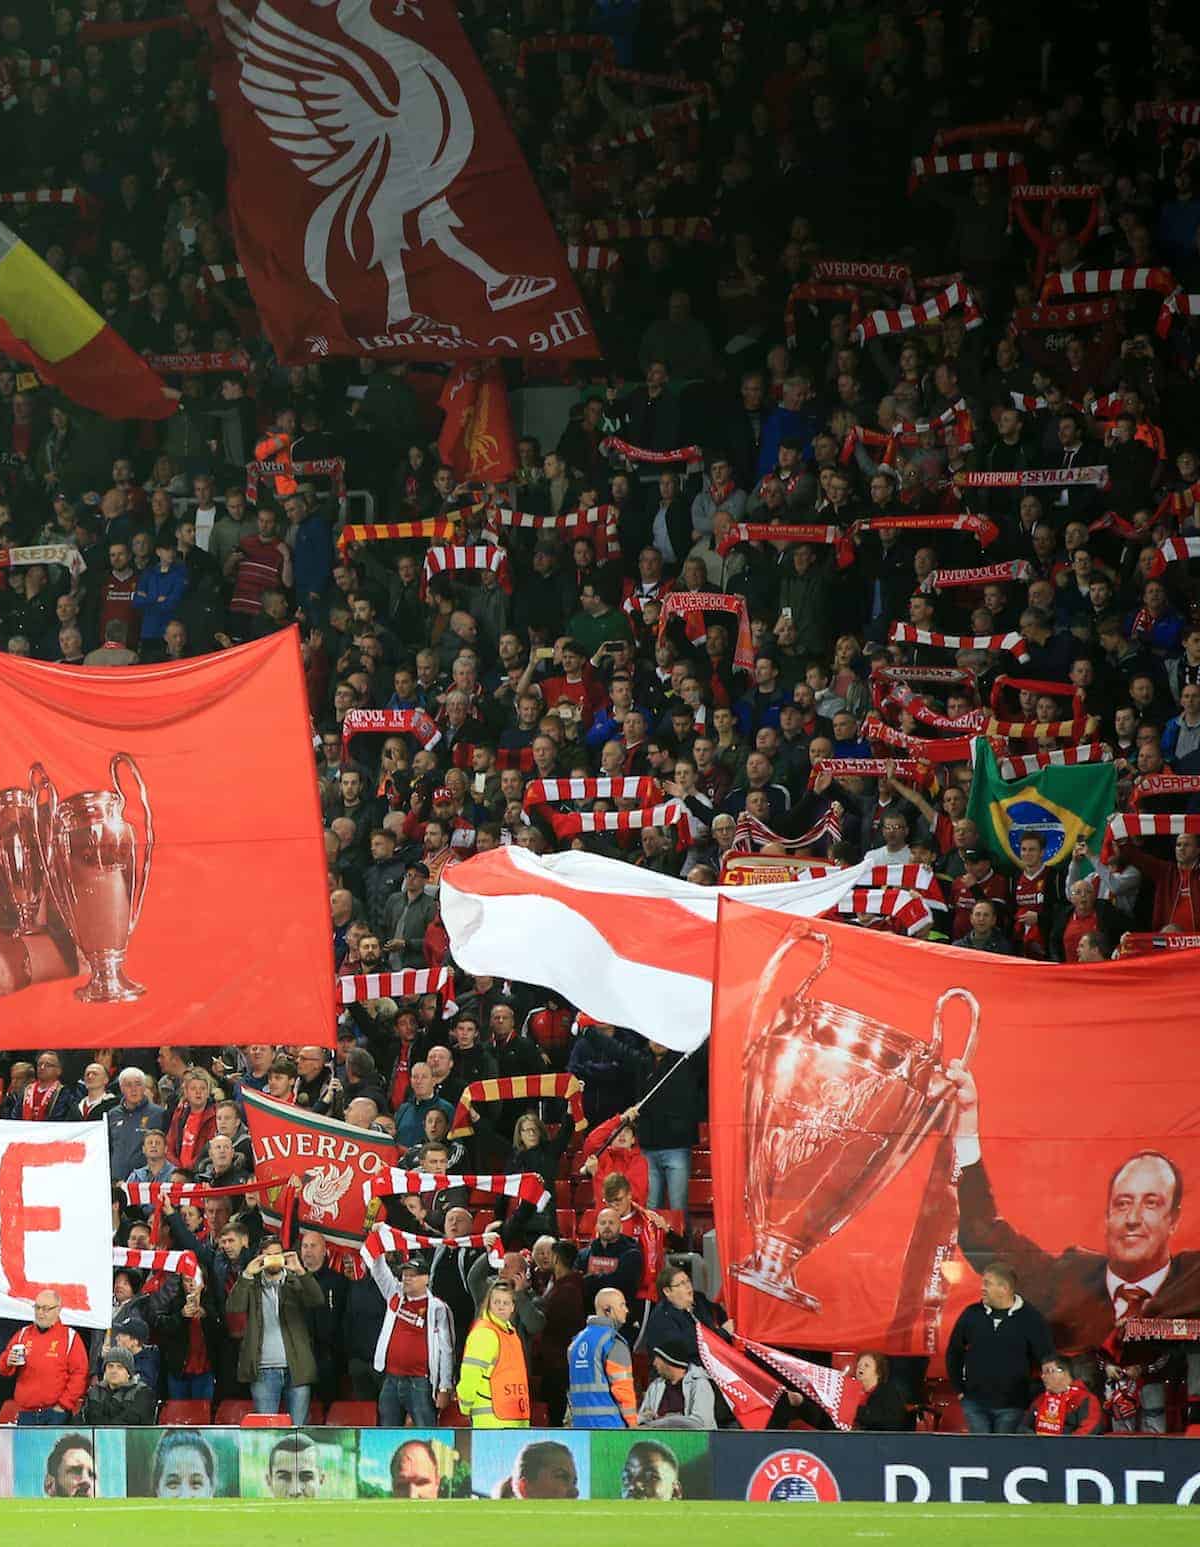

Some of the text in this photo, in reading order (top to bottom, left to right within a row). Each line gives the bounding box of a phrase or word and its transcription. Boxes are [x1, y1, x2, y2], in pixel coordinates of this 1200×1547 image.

[968, 467, 1075, 484] LIVERPOOL SEVILLA
[764, 1457, 820, 1482] UEFA
